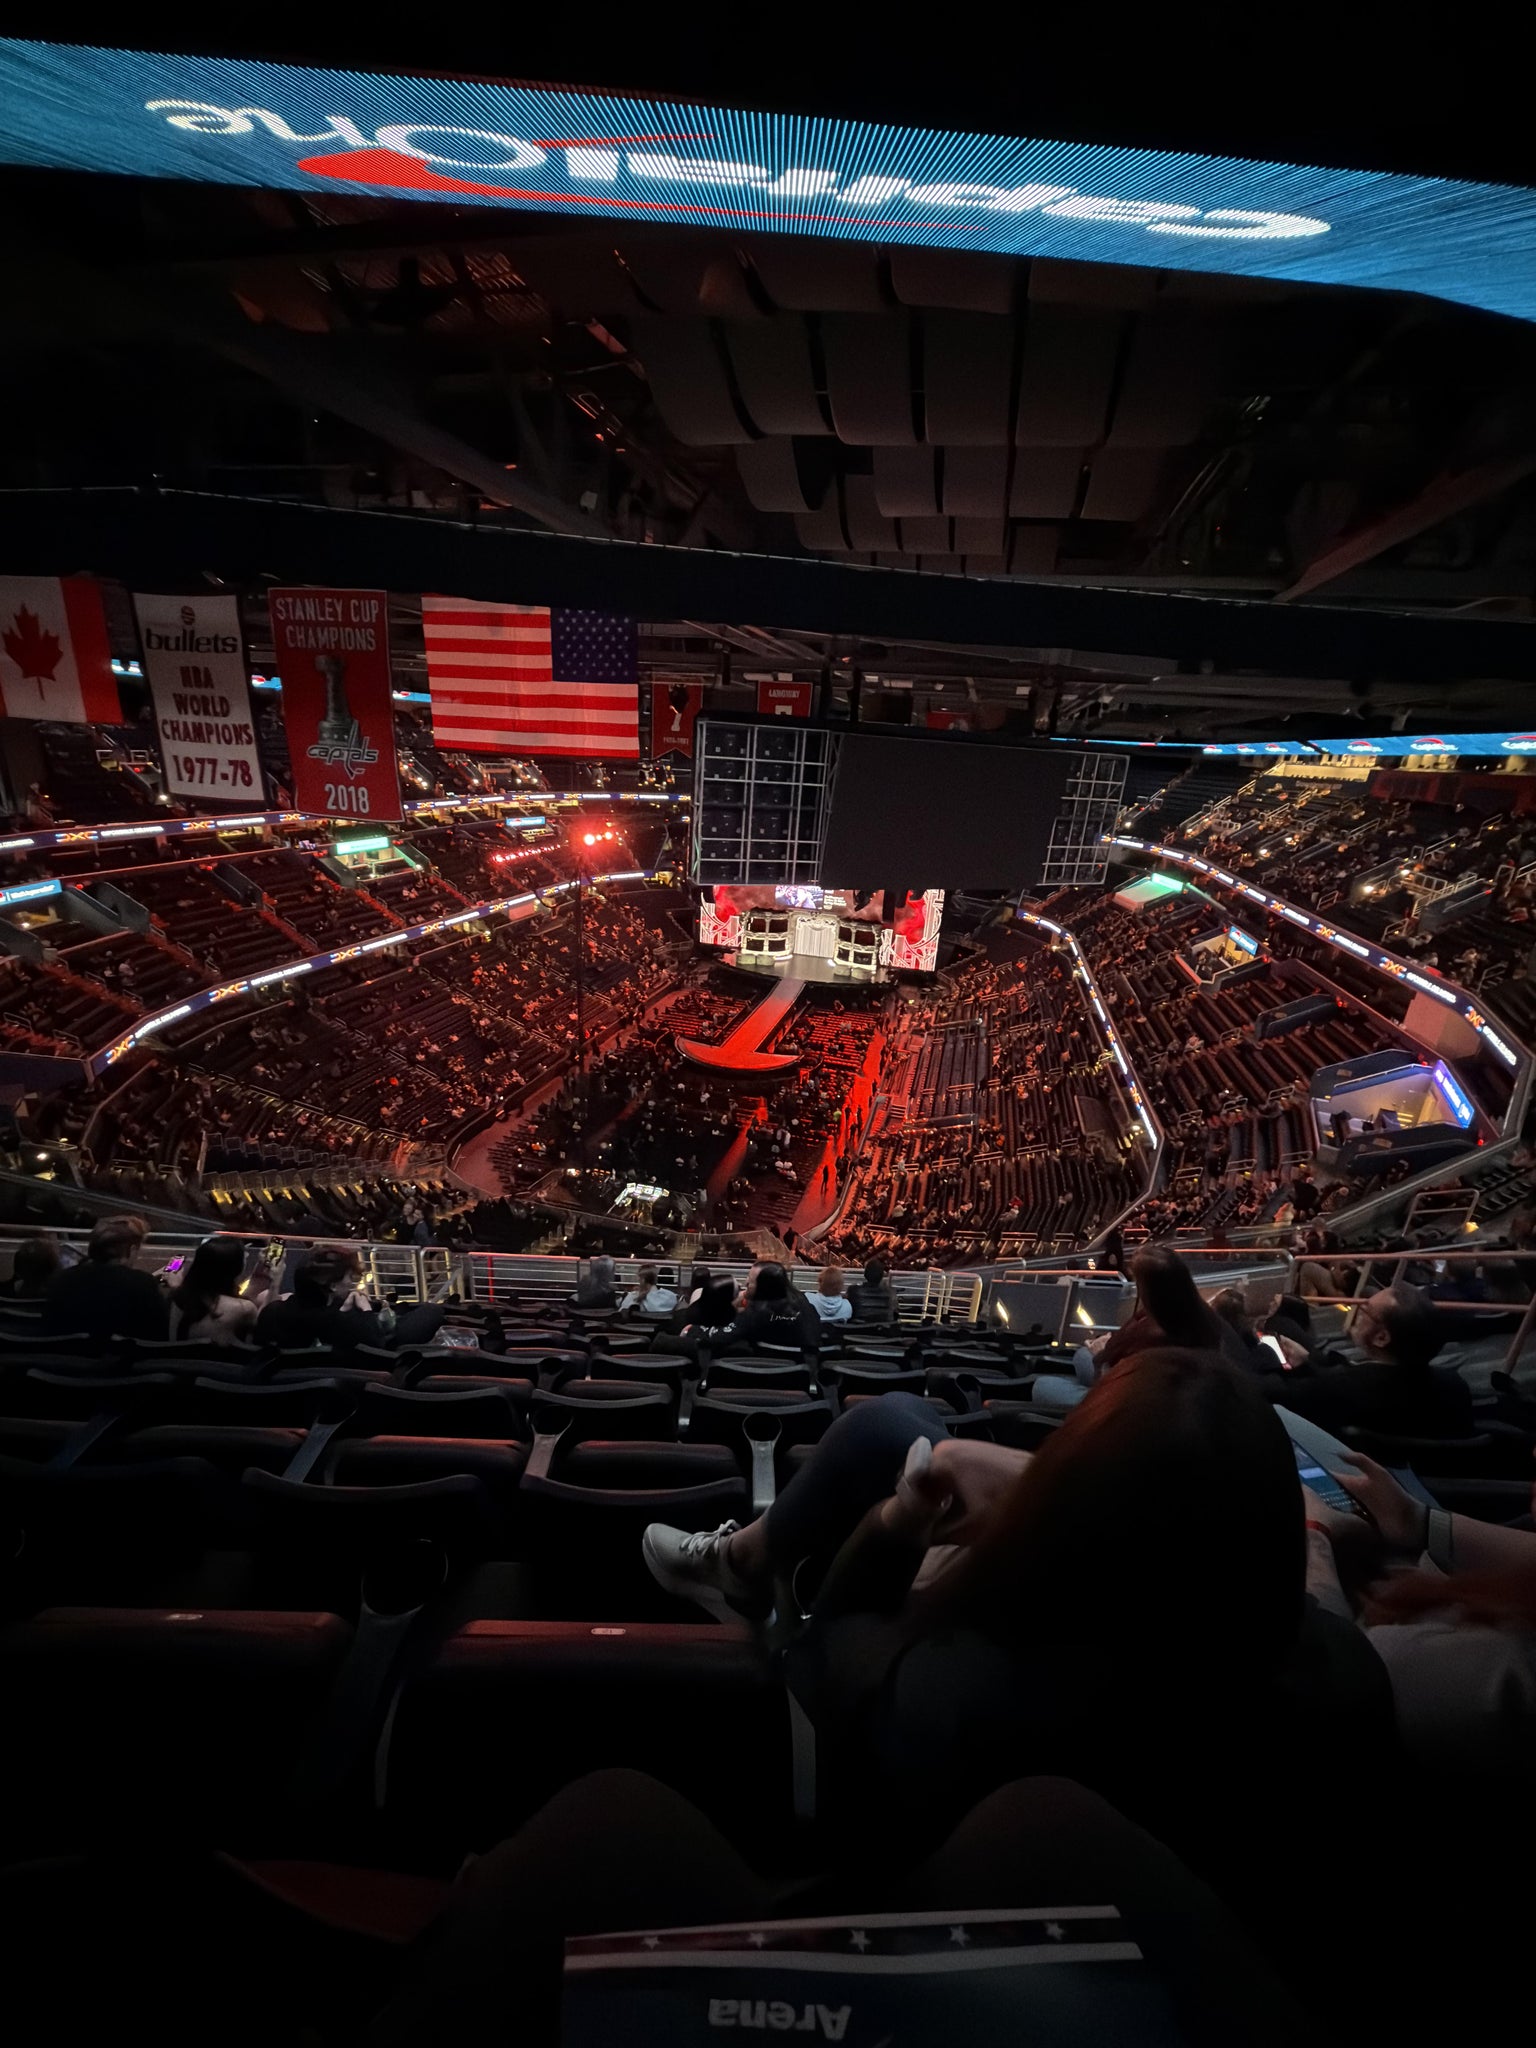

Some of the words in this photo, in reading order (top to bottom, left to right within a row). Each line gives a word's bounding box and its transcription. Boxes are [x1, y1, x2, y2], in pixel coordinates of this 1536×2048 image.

[145, 99, 546, 170] One
[566, 147, 1331, 240] Capital
[275, 597, 343, 622] STANLEY
[350, 599, 379, 623] CUP
[145, 628, 238, 653] bullets
[285, 625, 377, 651] CHAMPIONS
[180, 666, 214, 688] NBA
[172, 693, 230, 717] WORLD
[161, 718, 253, 745] CHAMPIONS
[172, 755, 253, 787] 1977-78
[324, 783, 370, 814] 2018
[708, 1997, 852, 2040] Arena
